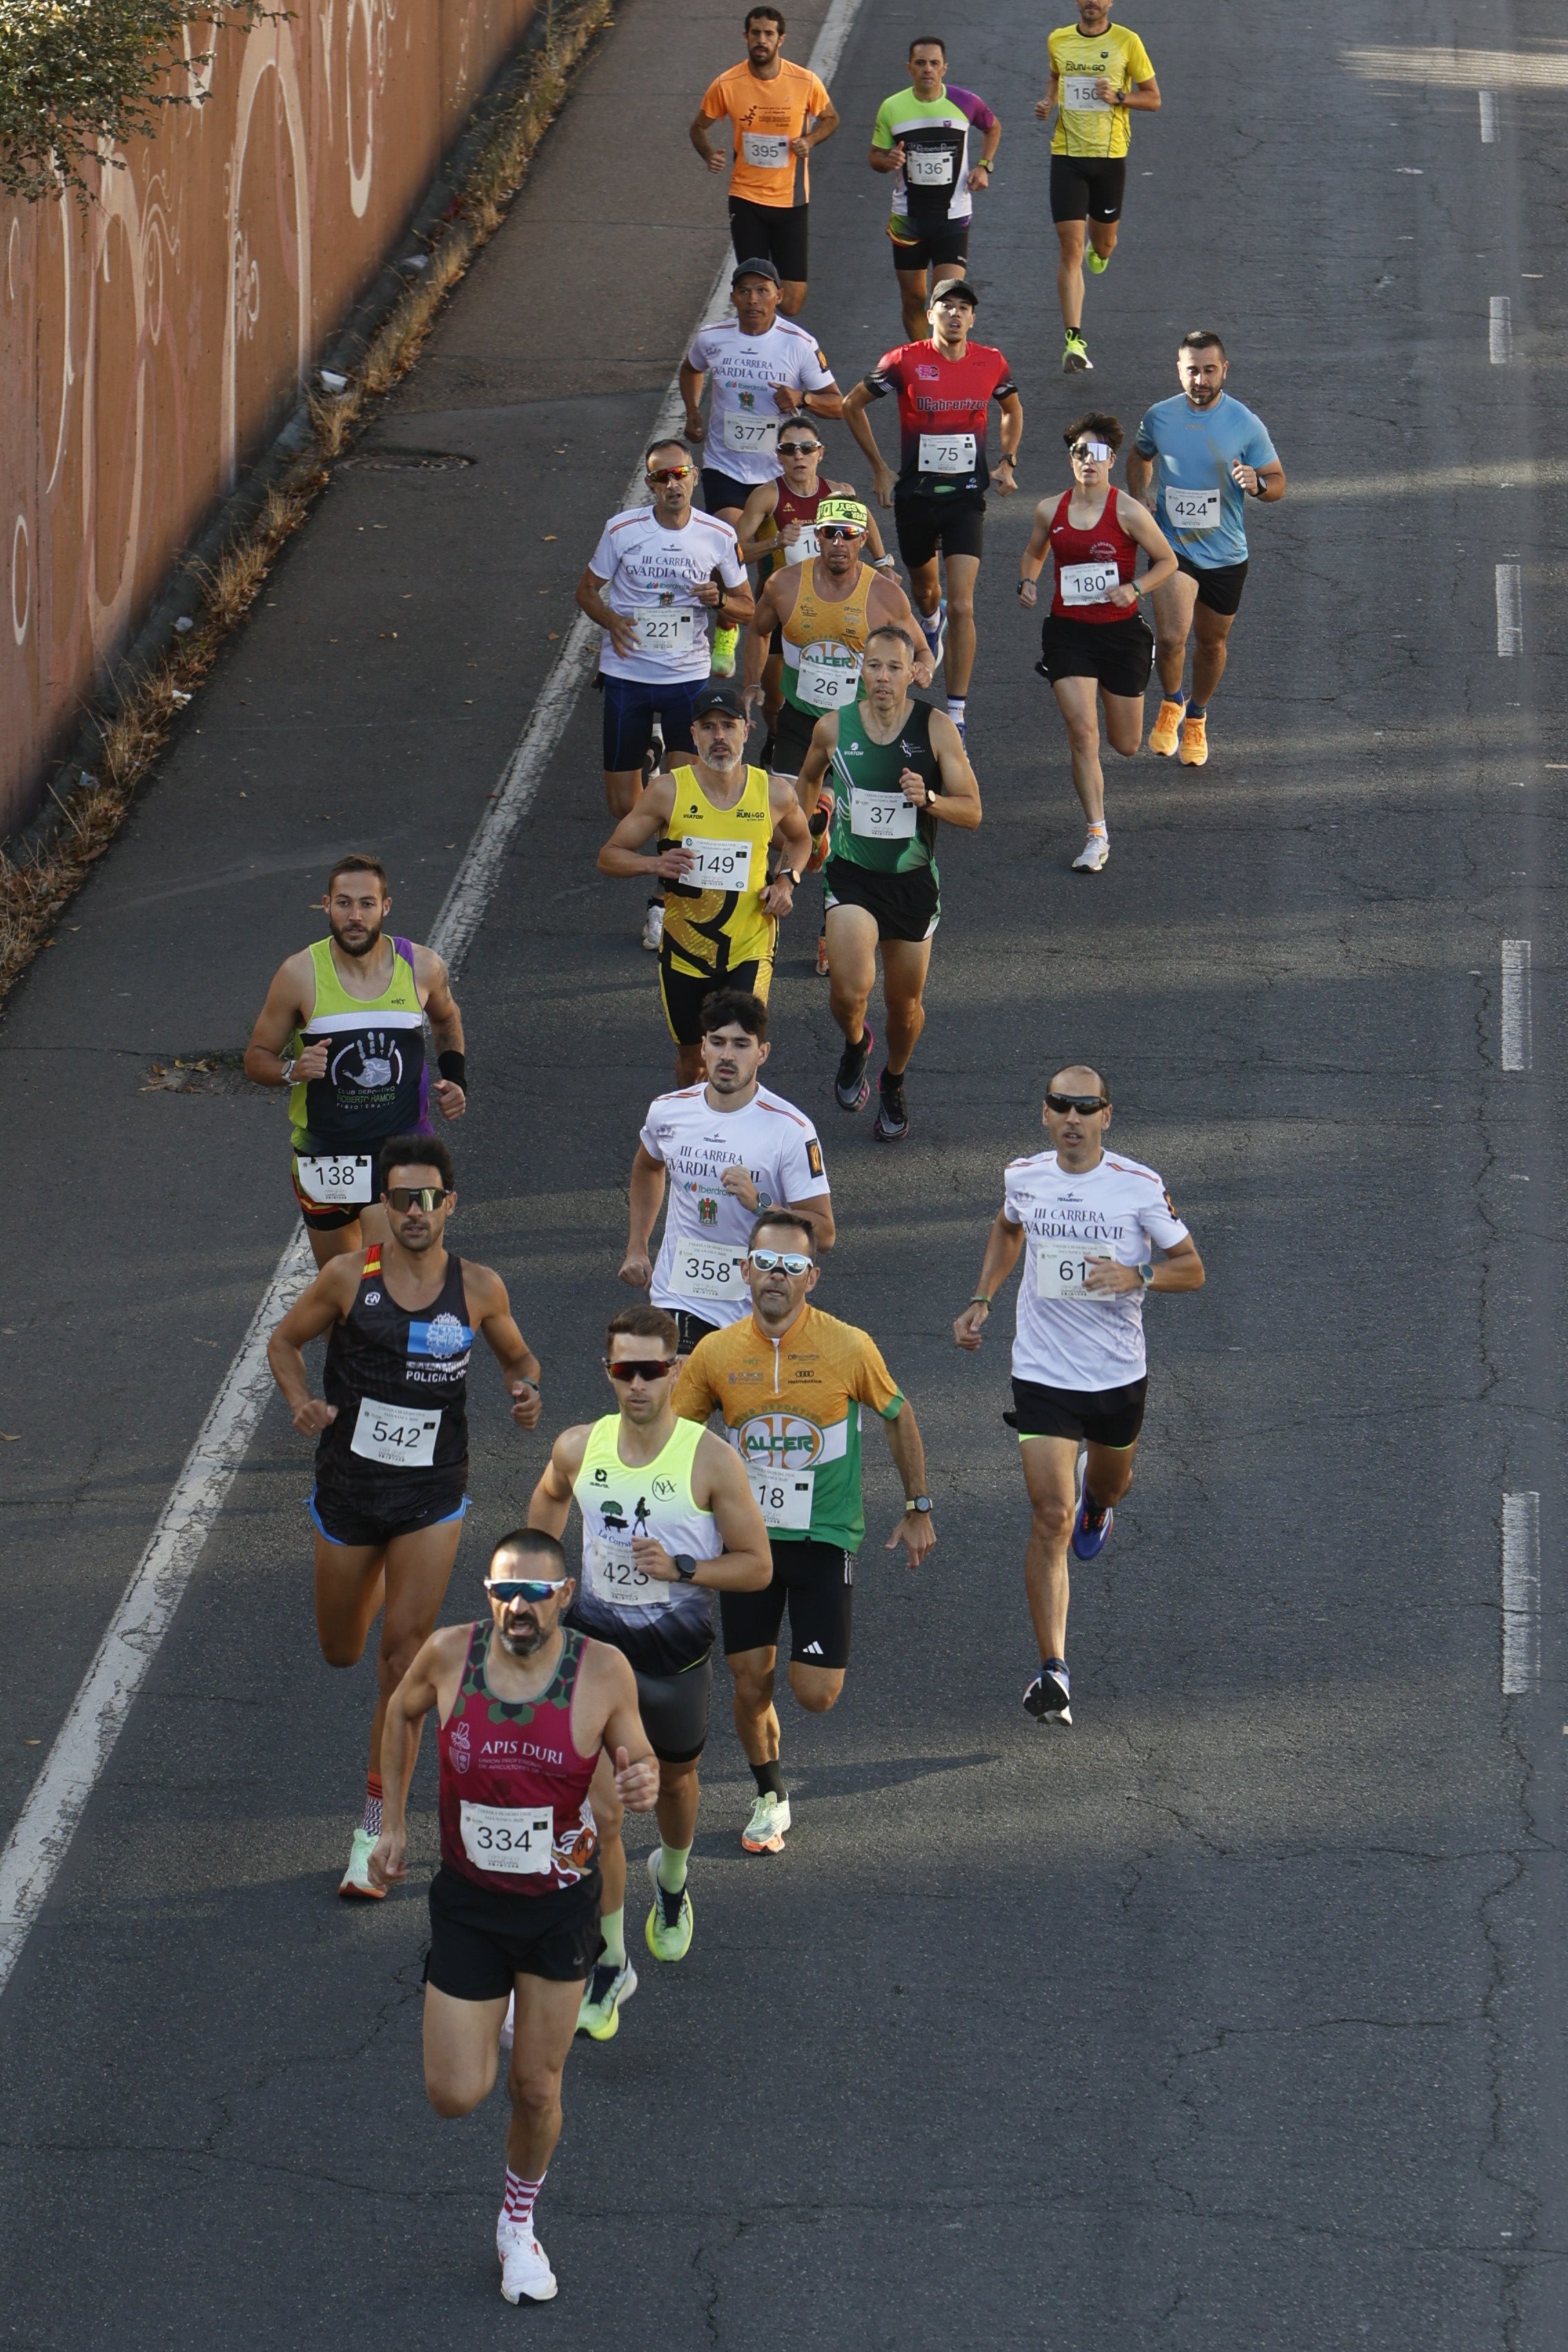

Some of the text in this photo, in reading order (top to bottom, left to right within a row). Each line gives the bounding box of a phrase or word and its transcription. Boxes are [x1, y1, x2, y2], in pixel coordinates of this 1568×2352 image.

[752, 144, 778, 157] 395
[917, 163, 943, 175] 136
[723, 357, 773, 370] III CARRERA
[758, 371, 787, 382] CIVIL
[738, 382, 767, 391] Iberdrola
[734, 426, 766, 440] 377
[937, 448, 958, 462] 75
[1175, 502, 1207, 516] 424
[642, 556, 696, 567] III CARRERA
[626, 565, 676, 578] GVARDIA
[1074, 576, 1106, 593] 180
[646, 622, 678, 637] 221
[805, 655, 852, 668] ALCER
[814, 678, 839, 696] 26
[870, 807, 896, 823] 37
[697, 854, 734, 874] 149
[337, 1092, 395, 1104] ROBERTO RAMOS
[679, 1146, 744, 1166] III CARRERA
[315, 1166, 355, 1186] 138
[1035, 1208, 1106, 1223] III CARRERA
[1084, 1226, 1126, 1240] CIVIL
[685, 1258, 730, 1282] 358
[1059, 1261, 1086, 1281] 61
[406, 1370, 447, 1382] POLICIA
[372, 1420, 420, 1448] 542
[745, 1435, 814, 1453] ALCER
[759, 1485, 784, 1508] 18
[598, 1529, 607, 1540] La
[481, 1741, 563, 1765] APIS DURI
[477, 1826, 532, 1852] 334
